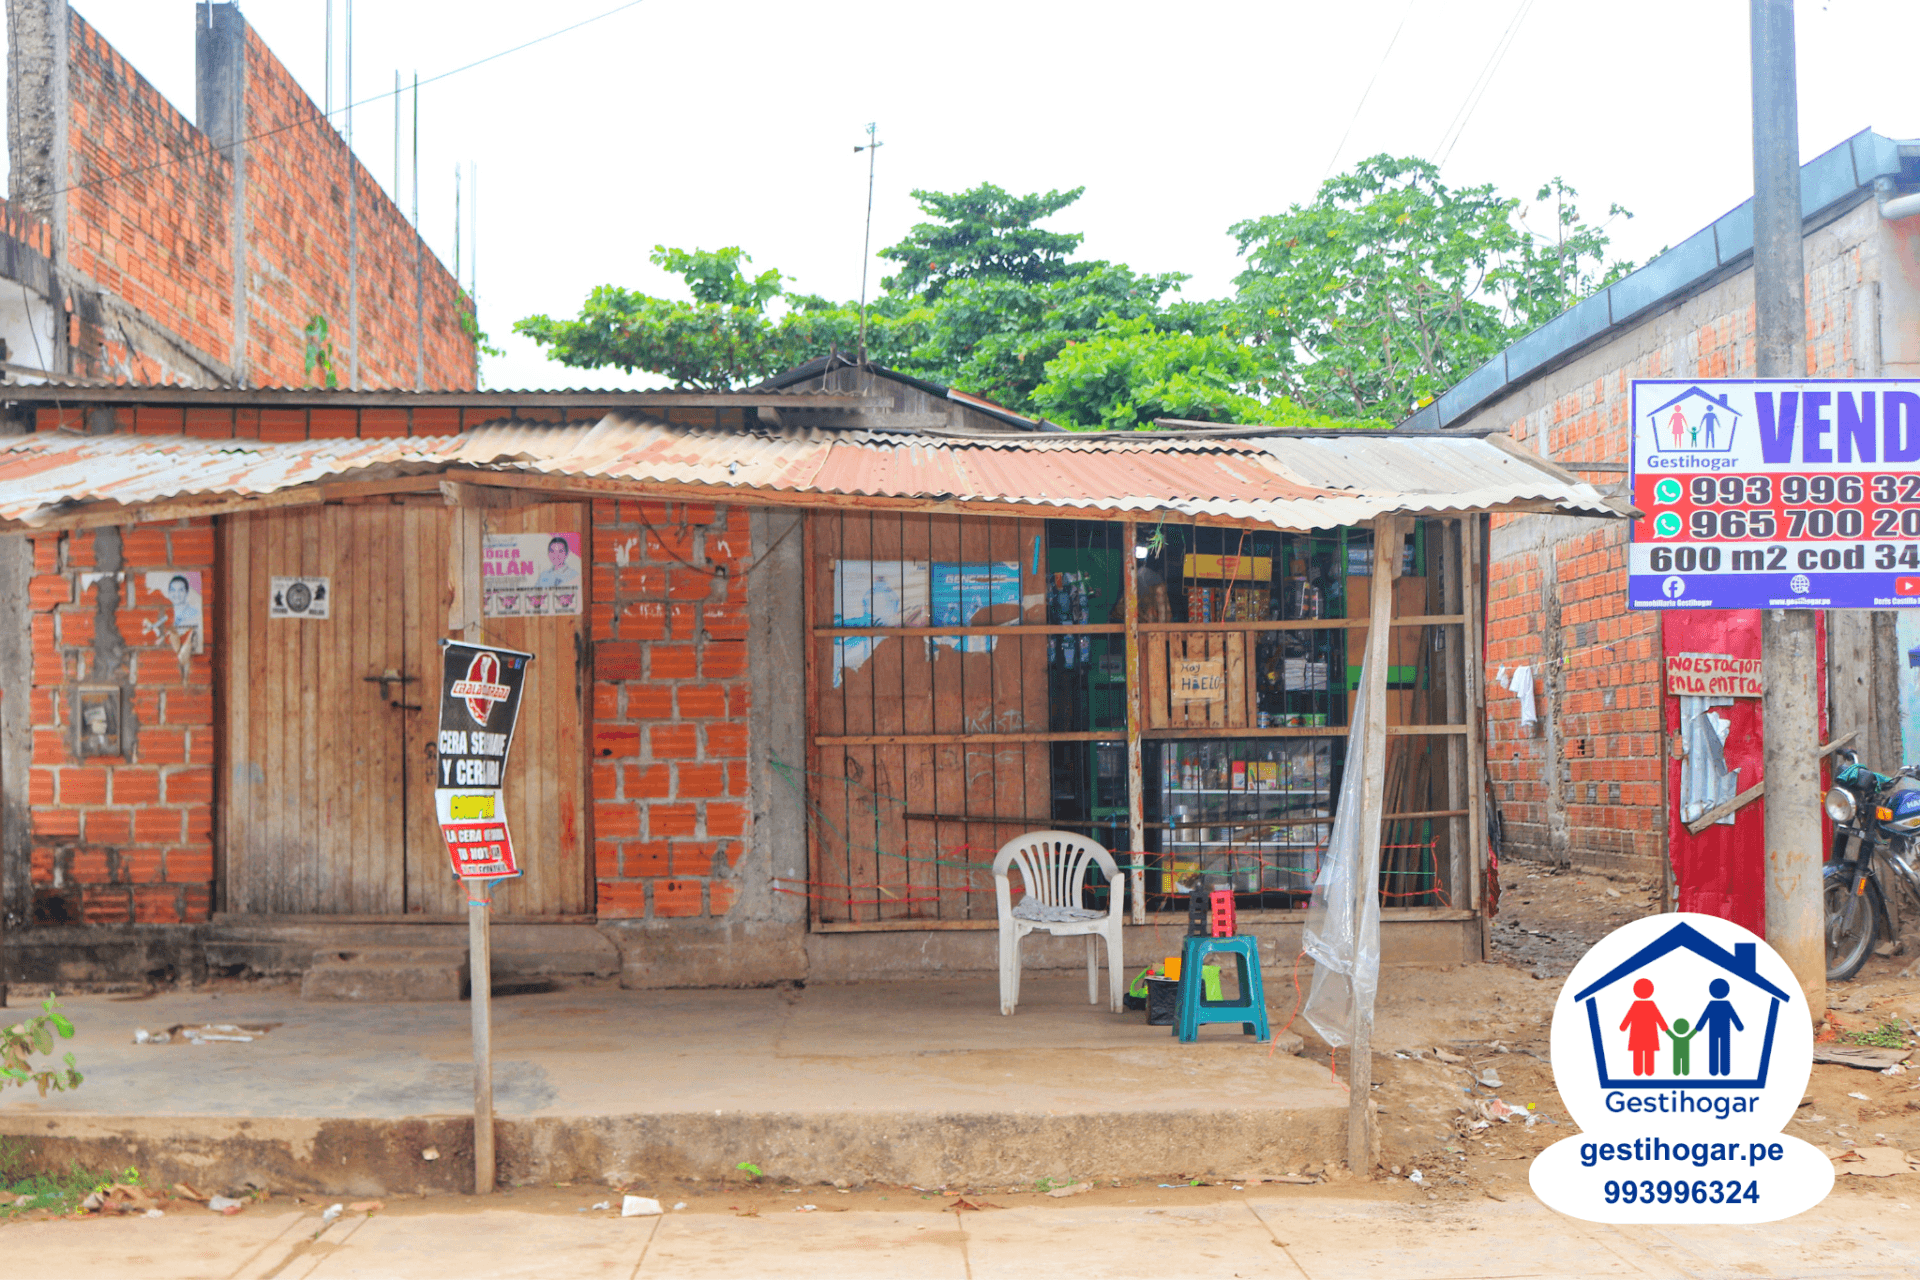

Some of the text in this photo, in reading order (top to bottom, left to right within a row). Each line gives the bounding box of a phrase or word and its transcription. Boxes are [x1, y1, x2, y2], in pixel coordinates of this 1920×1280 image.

[1754, 391, 1920, 463] VEND
[1647, 455, 1739, 471] Gestihogar
[1691, 475, 1920, 505] 993 996 32
[1691, 509, 1920, 538] 965 700 20
[1650, 544, 1920, 571] 600 m2 cod 34
[1677, 599, 1713, 608] Gestihogar
[1669, 657, 1693, 672] NO
[439, 730, 468, 755] CERA
